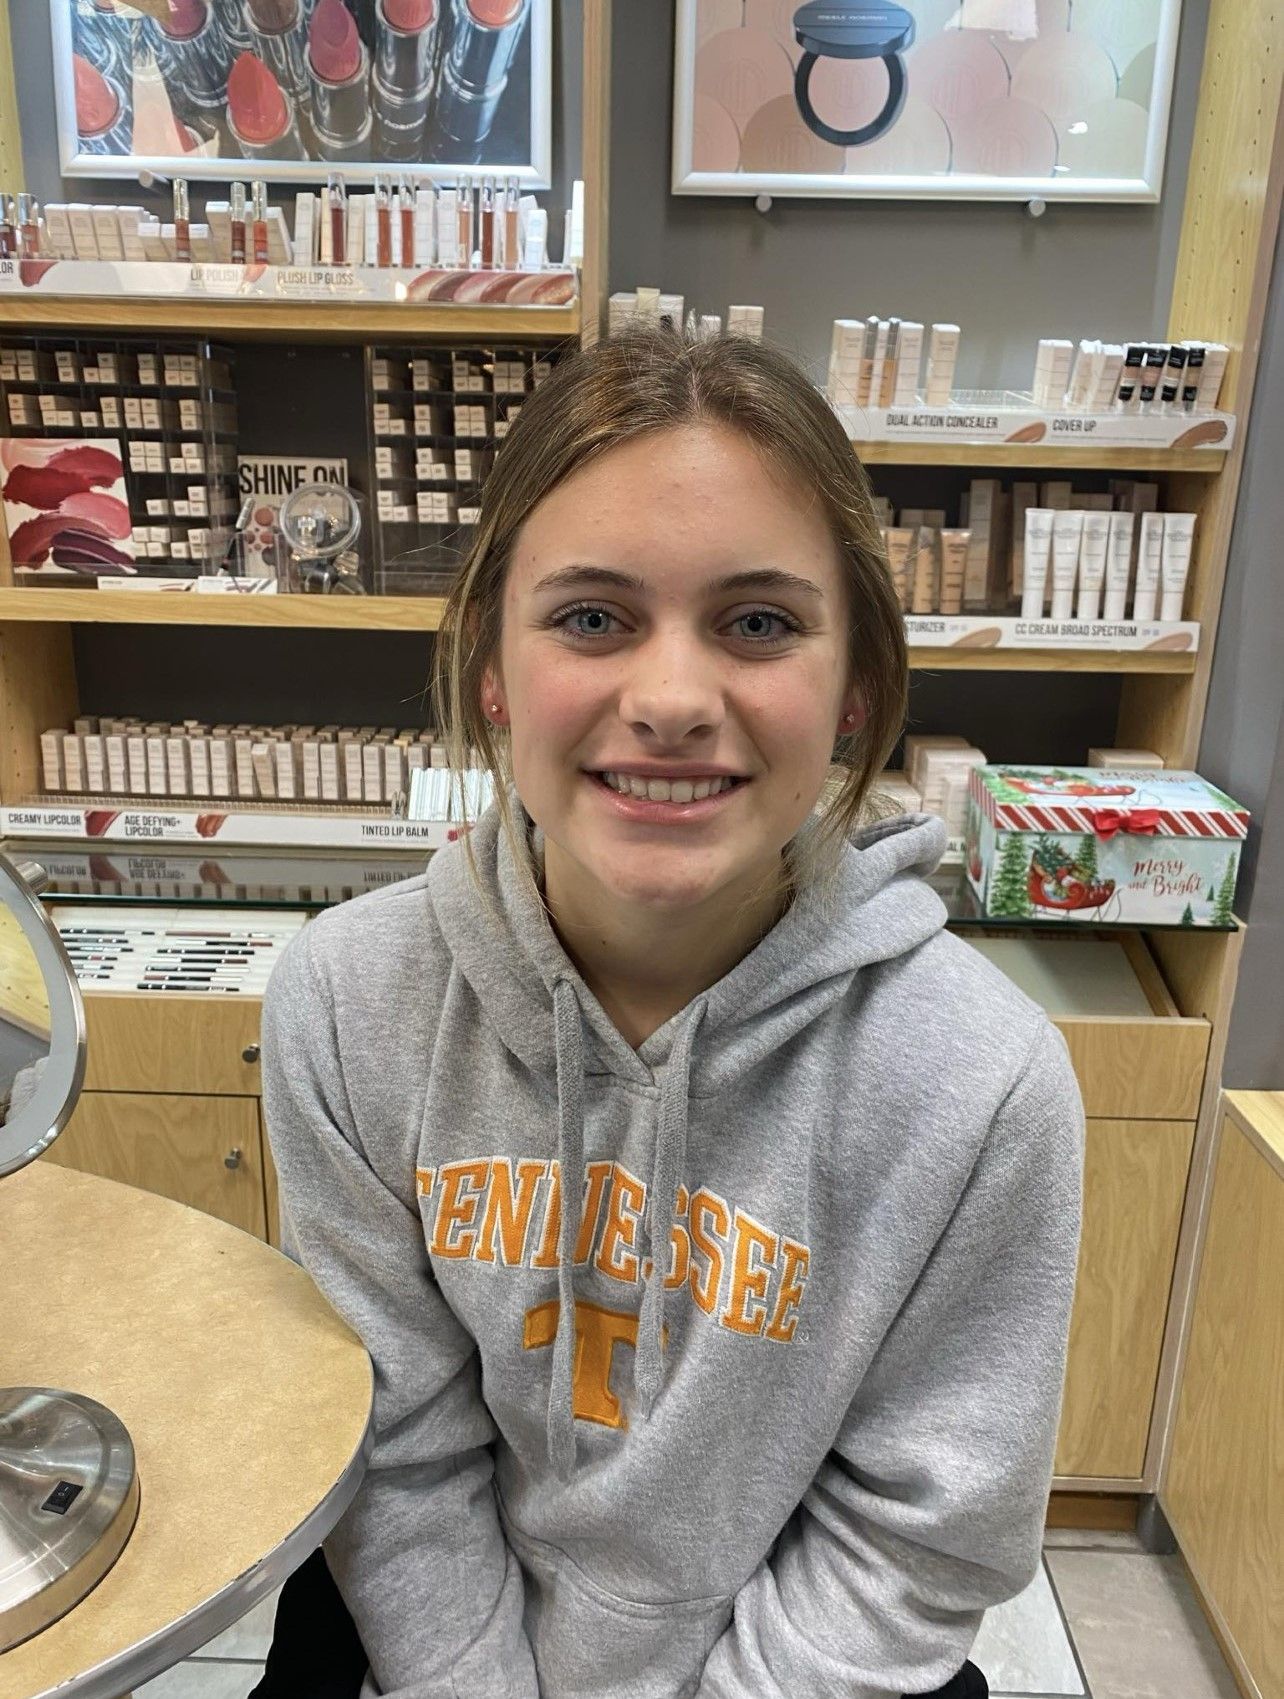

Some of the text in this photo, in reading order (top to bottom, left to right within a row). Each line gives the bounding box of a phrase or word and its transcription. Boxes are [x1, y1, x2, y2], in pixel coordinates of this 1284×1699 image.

[278, 270, 354, 285] PLUSH LIP GLOSS
[886, 413, 998, 429] DUAL ACTION CONCEALER
[1052, 418, 1097, 432] COVER UP
[239, 463, 345, 495] SHINE ON
[1015, 623, 1026, 635] CC
[1028, 623, 1058, 635] CREAM
[1060, 624, 1089, 636] BROAD
[1091, 625, 1137, 638] SPECTRUM
[8, 813, 81, 826] CREAMY LIPCOLOR
[125, 815, 141, 827] AGE
[125, 826, 164, 837] LIPCOLOR
[362, 825, 429, 837] TINTED LIP BALM
[1133, 858, 1184, 877] Merry
[1153, 872, 1203, 898] Bright
[523, 1297, 669, 1430] T
